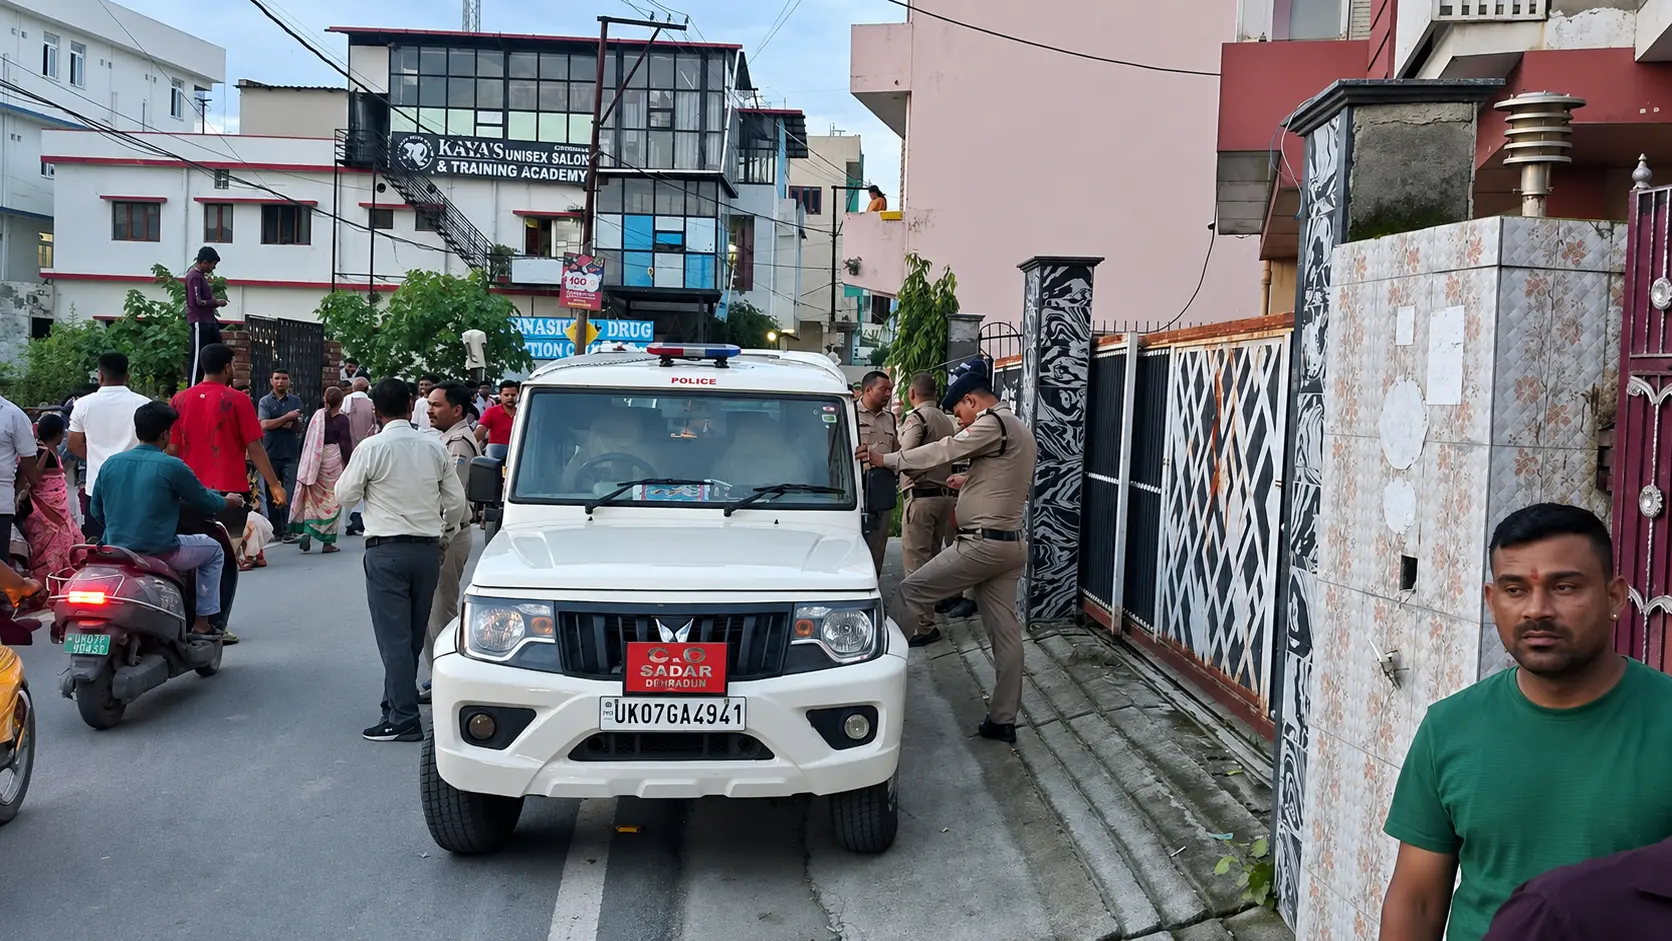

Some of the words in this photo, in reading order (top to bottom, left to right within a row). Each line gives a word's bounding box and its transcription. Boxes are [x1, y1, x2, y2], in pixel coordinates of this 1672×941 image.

[438, 138, 504, 159] KAYA'S
[505, 149, 549, 164] UNISEX
[551, 152, 590, 166] SALON
[436, 160, 448, 173] &
[450, 160, 518, 177] TRAINING
[520, 165, 588, 182] ACADEMY
[607, 320, 652, 338] DRUG
[671, 377, 717, 385] POLICE
[640, 664, 712, 677] SADAR
[614, 703, 742, 725] UK07GA4941
